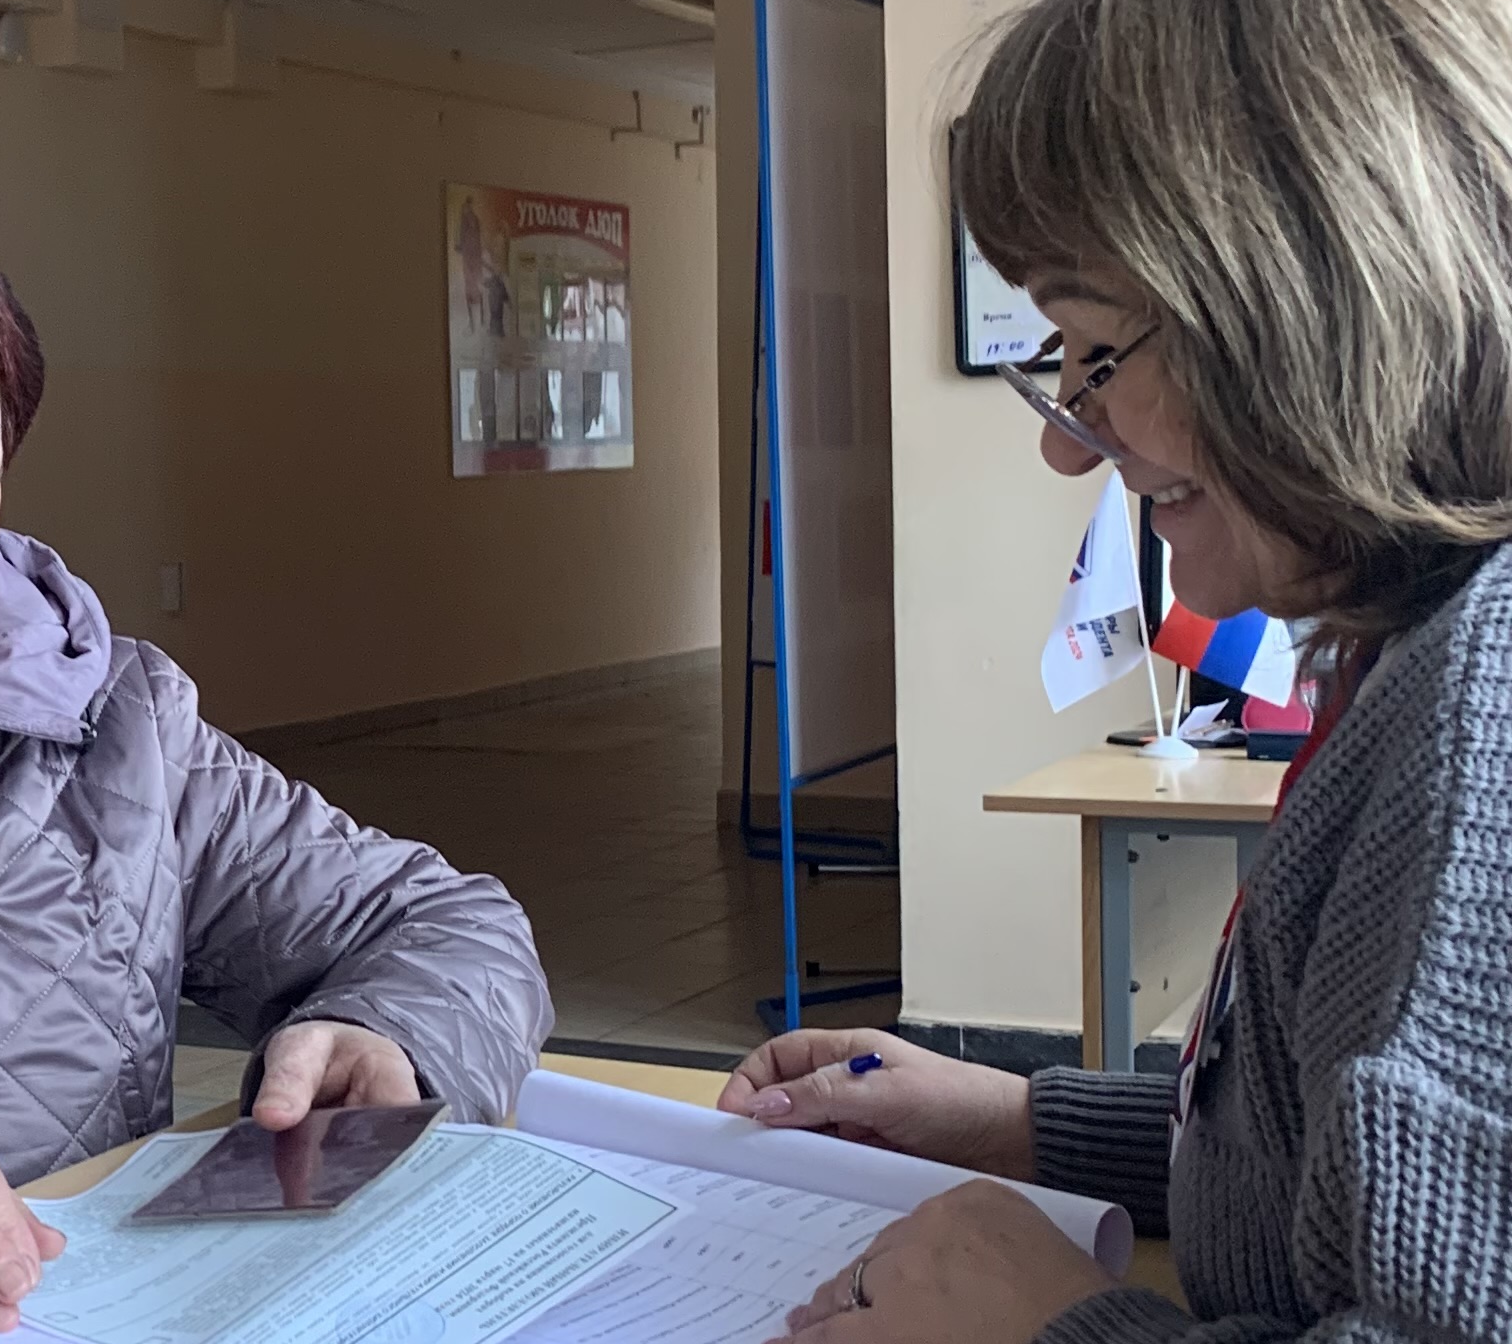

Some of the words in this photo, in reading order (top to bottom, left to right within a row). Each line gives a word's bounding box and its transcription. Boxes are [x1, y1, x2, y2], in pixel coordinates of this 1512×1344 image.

[516, 199, 580, 228] УГОЛОК
[984, 313, 1012, 323] Время
[544, 1213, 599, 1250] Президента
[496, 1249, 550, 1284] Российской
